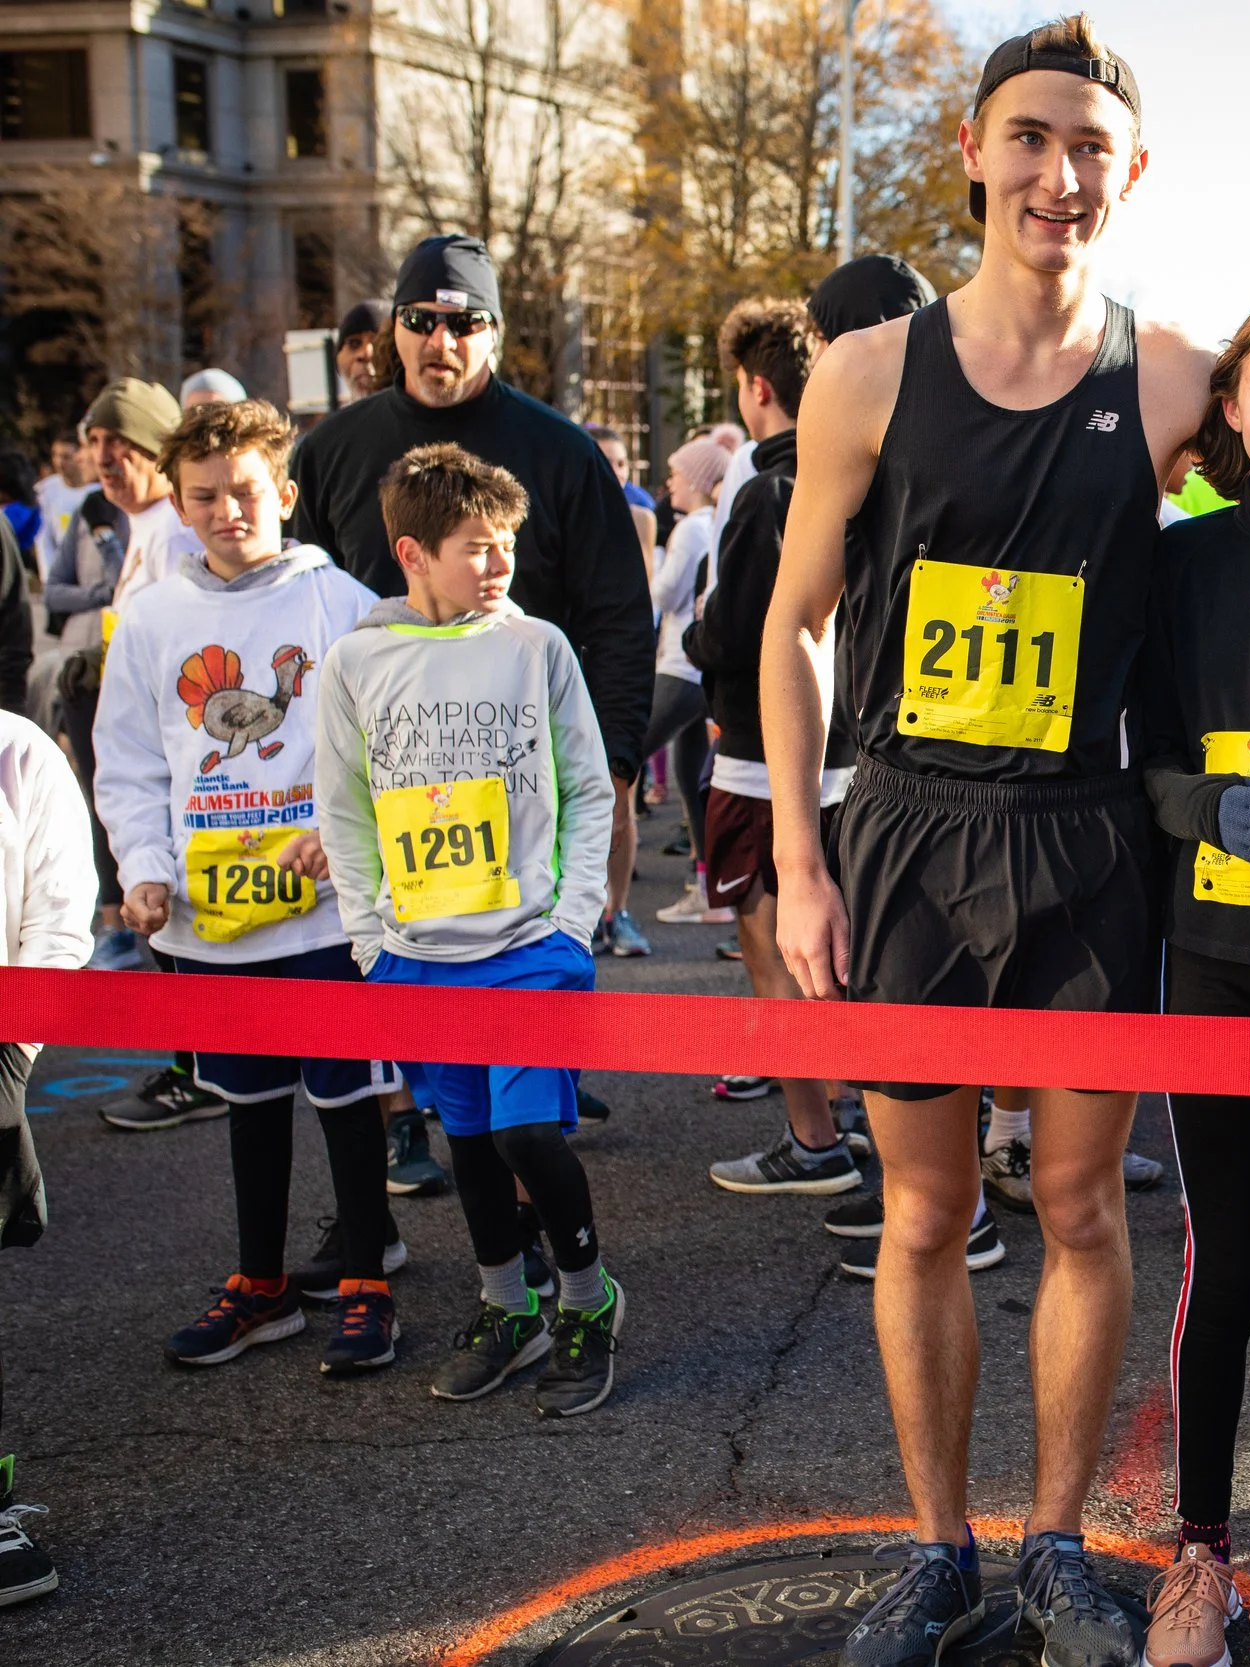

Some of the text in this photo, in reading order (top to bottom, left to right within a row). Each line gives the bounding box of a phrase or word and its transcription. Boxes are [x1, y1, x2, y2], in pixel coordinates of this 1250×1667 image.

[919, 618, 1055, 689] 2111
[919, 685, 942, 693] FLEET
[920, 691, 941, 700] FEET
[368, 700, 538, 734] HAMPIONS
[383, 728, 510, 751] RUN HARD
[400, 751, 492, 767] WHEN IT'S
[193, 773, 231, 783] tlantic
[221, 781, 250, 791] Bank
[370, 771, 428, 793] HRD
[185, 783, 313, 812] RUMSTICK DASH
[266, 802, 314, 824] 2019
[395, 820, 497, 873] 1291
[201, 863, 303, 905] 1290
